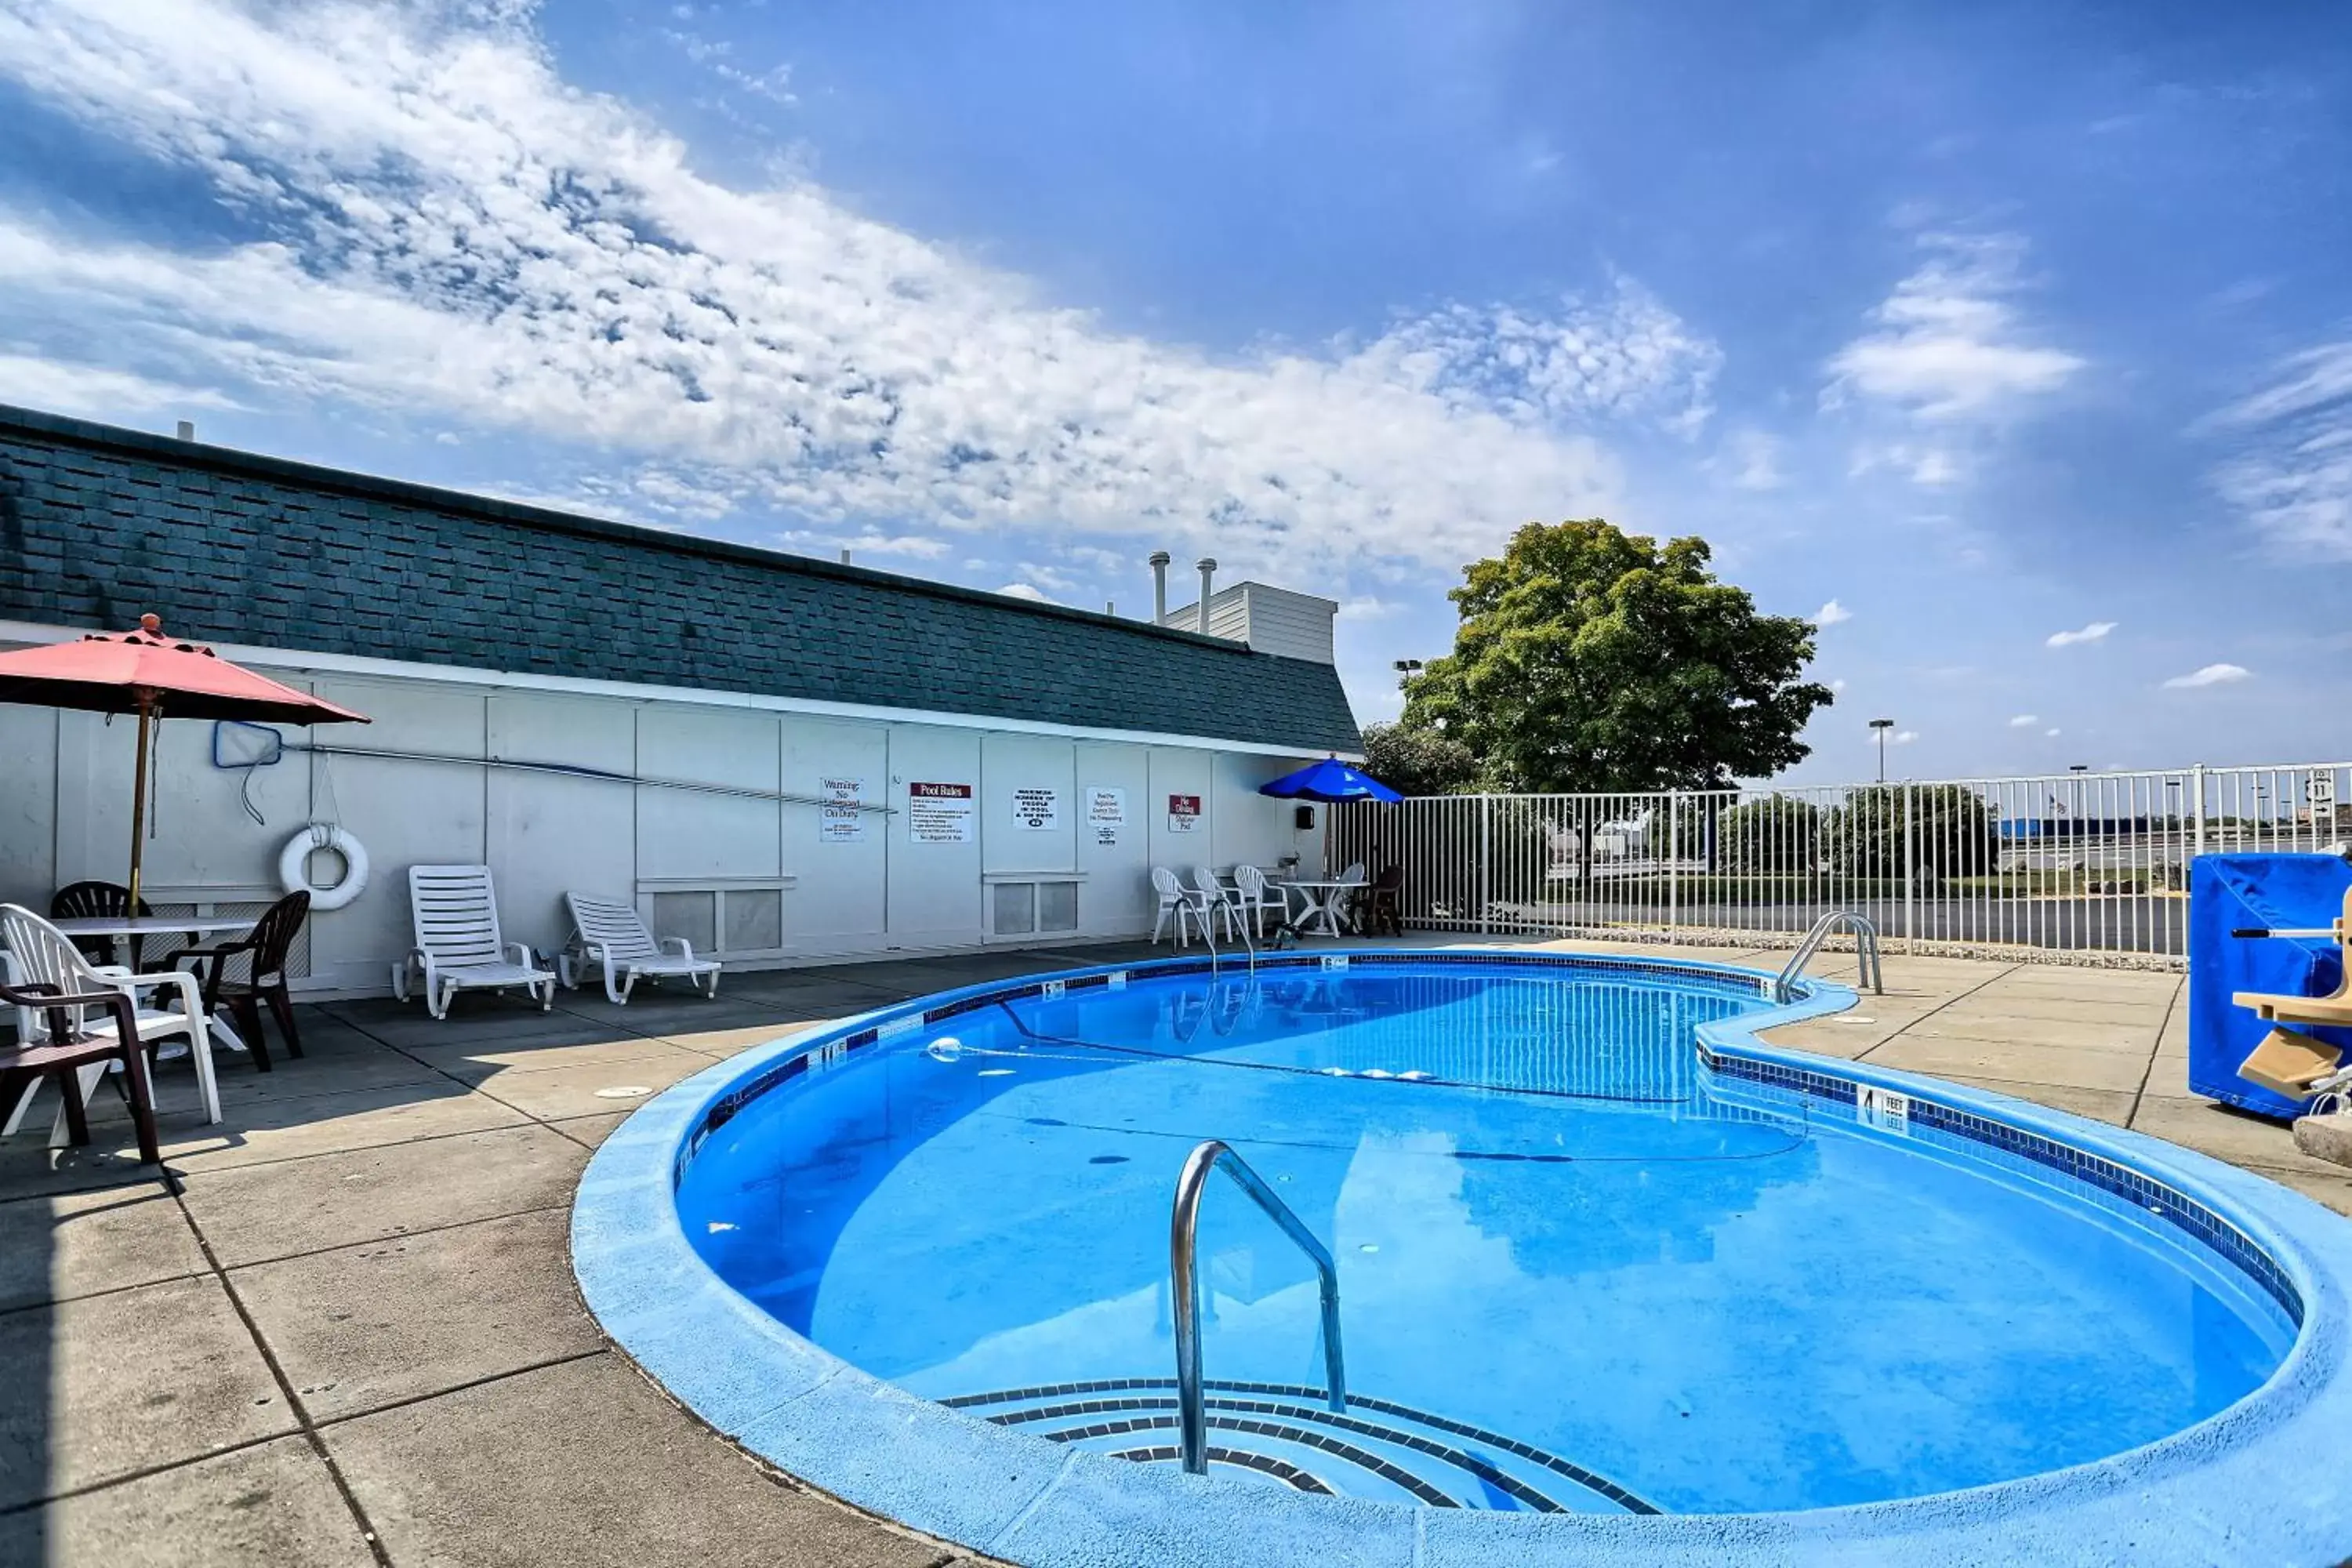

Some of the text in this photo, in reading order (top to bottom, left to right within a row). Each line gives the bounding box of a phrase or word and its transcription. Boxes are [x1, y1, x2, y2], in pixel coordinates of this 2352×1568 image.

[824, 780, 860, 792] Warning
[921, 785, 962, 797] Pool Rules
[1886, 1096, 1903, 1111] FEET
